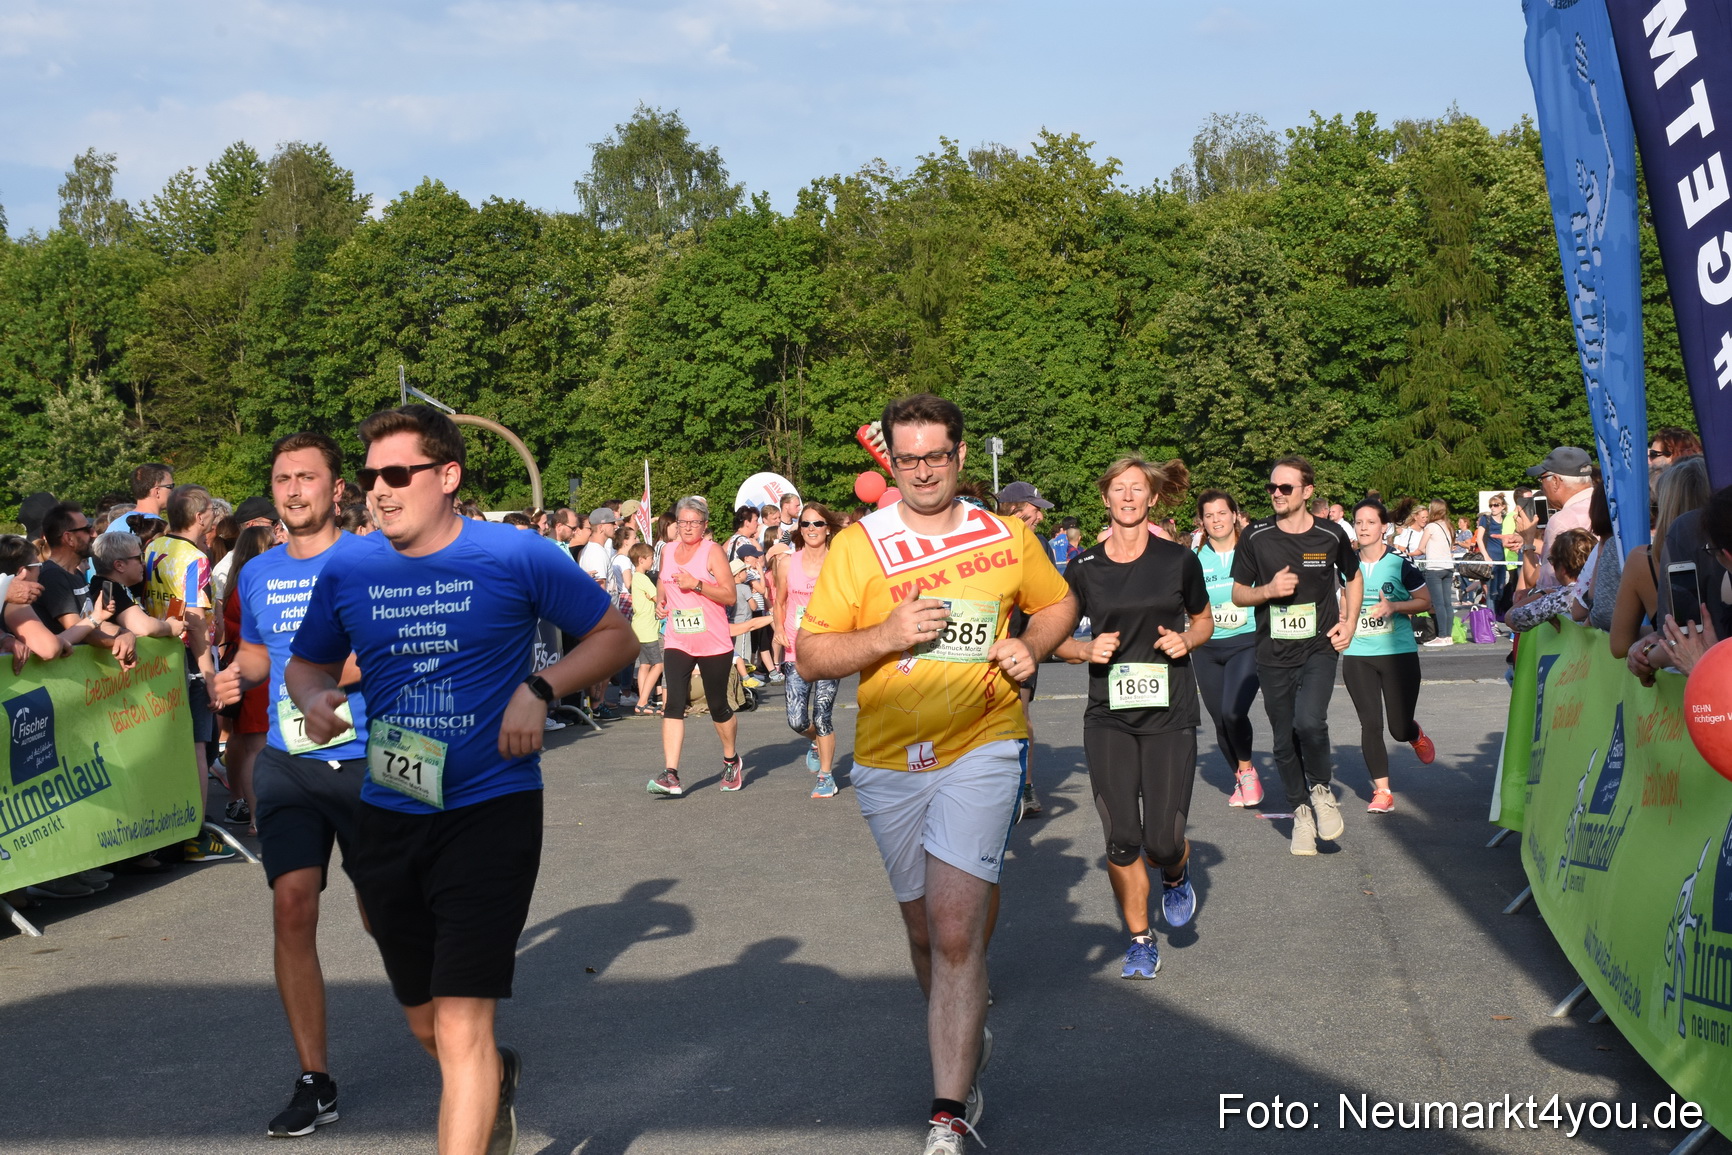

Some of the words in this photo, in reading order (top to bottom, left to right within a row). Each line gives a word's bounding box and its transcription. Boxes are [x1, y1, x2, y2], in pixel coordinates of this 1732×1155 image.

[266, 578, 297, 591] Wenn
[299, 579, 310, 588] es
[890, 569, 951, 603] MAX
[956, 549, 1019, 579] BÖGL
[368, 585, 413, 600] Wenn
[416, 585, 432, 596] es
[435, 579, 474, 595] beim
[372, 596, 472, 621] Hausverkauf
[675, 617, 700, 627] 1114
[1214, 613, 1238, 623] 970
[1280, 617, 1307, 630] 140
[1361, 616, 1384, 629] 968
[398, 621, 447, 639] richtig
[932, 621, 987, 646] 585
[390, 639, 460, 656] LAUFEN
[412, 657, 440, 673] soll!
[85, 670, 132, 706] Gesunde
[1115, 678, 1160, 696] 1869
[108, 698, 153, 735] laufen
[147, 679, 186, 722] länger!
[1692, 703, 1712, 713] DEHN
[19, 715, 49, 739] Fischer
[1694, 713, 1725, 725] richtigen
[383, 750, 423, 785] 721
[13, 815, 65, 851] neumarkt
